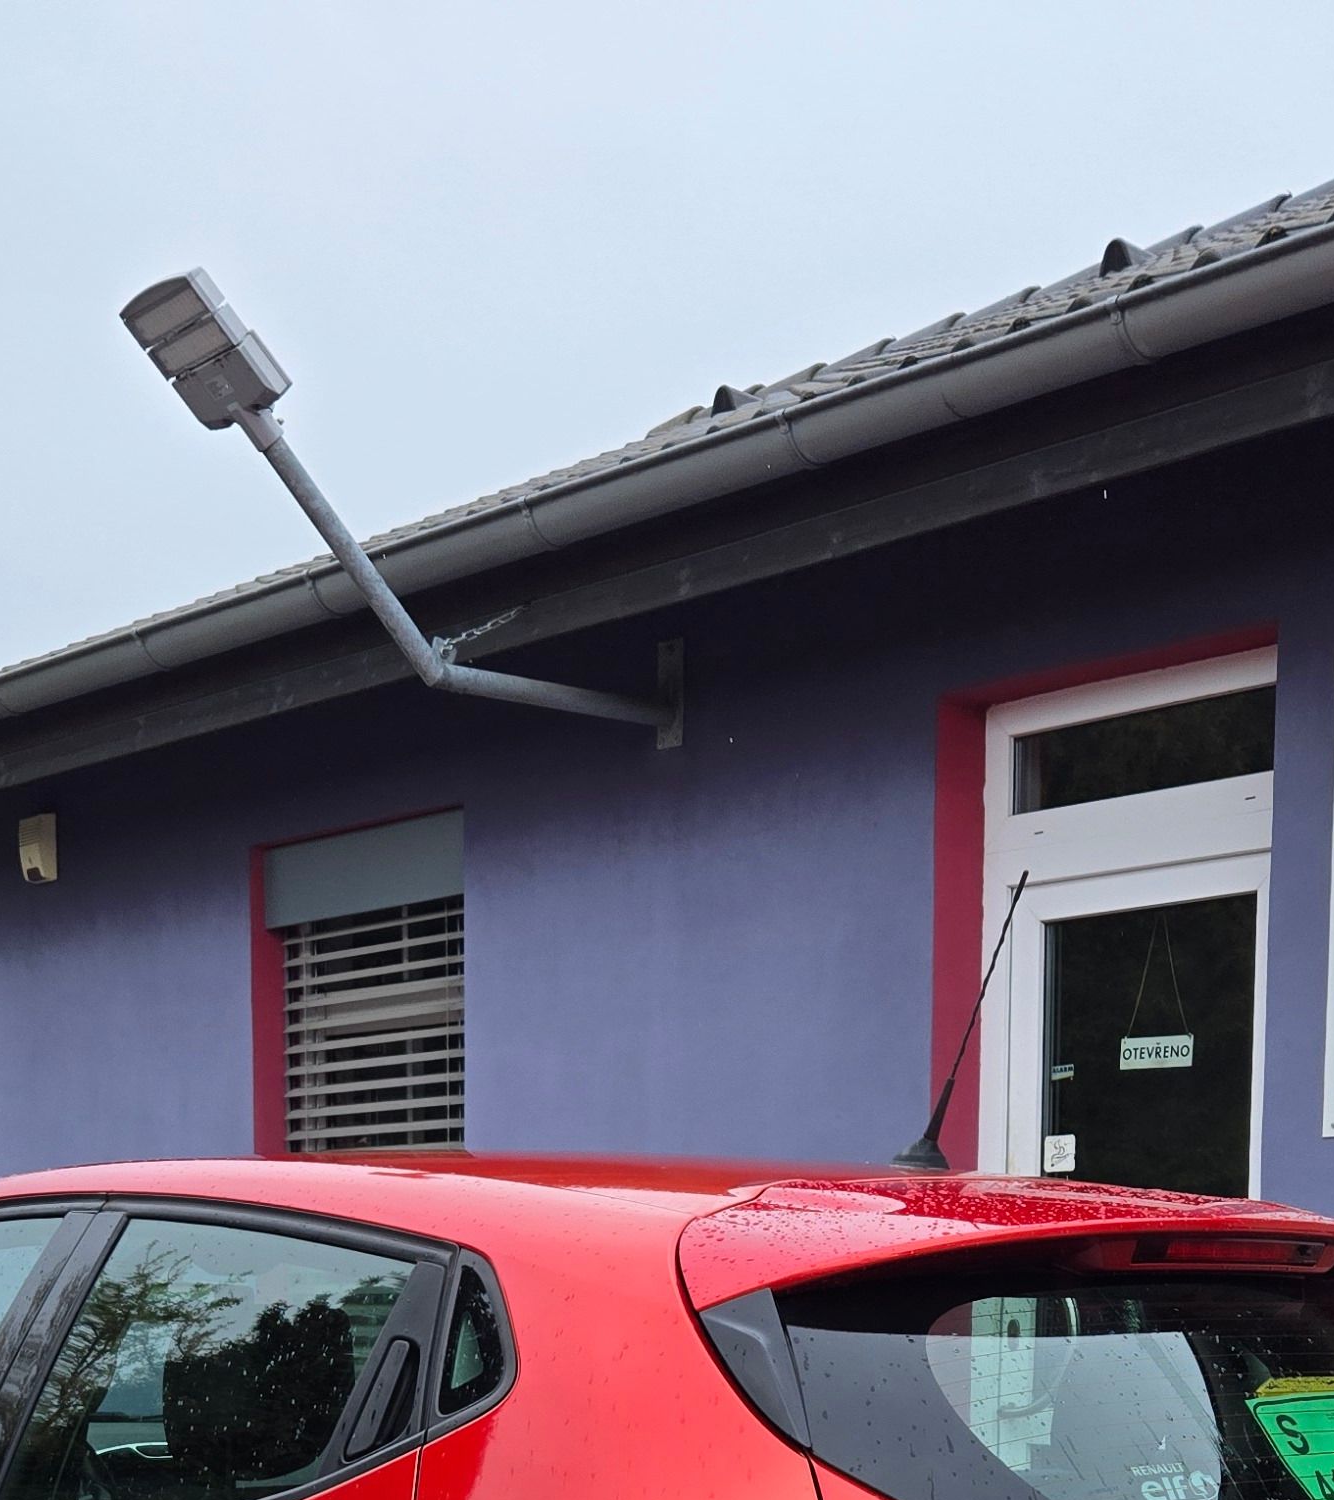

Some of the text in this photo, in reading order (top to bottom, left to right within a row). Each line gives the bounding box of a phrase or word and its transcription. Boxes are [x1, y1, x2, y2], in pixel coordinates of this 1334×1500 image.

[1123, 1042, 1190, 1061] OTEVŘENO
[1276, 1414, 1310, 1455] S
[1130, 1462, 1186, 1477] RENAULT
